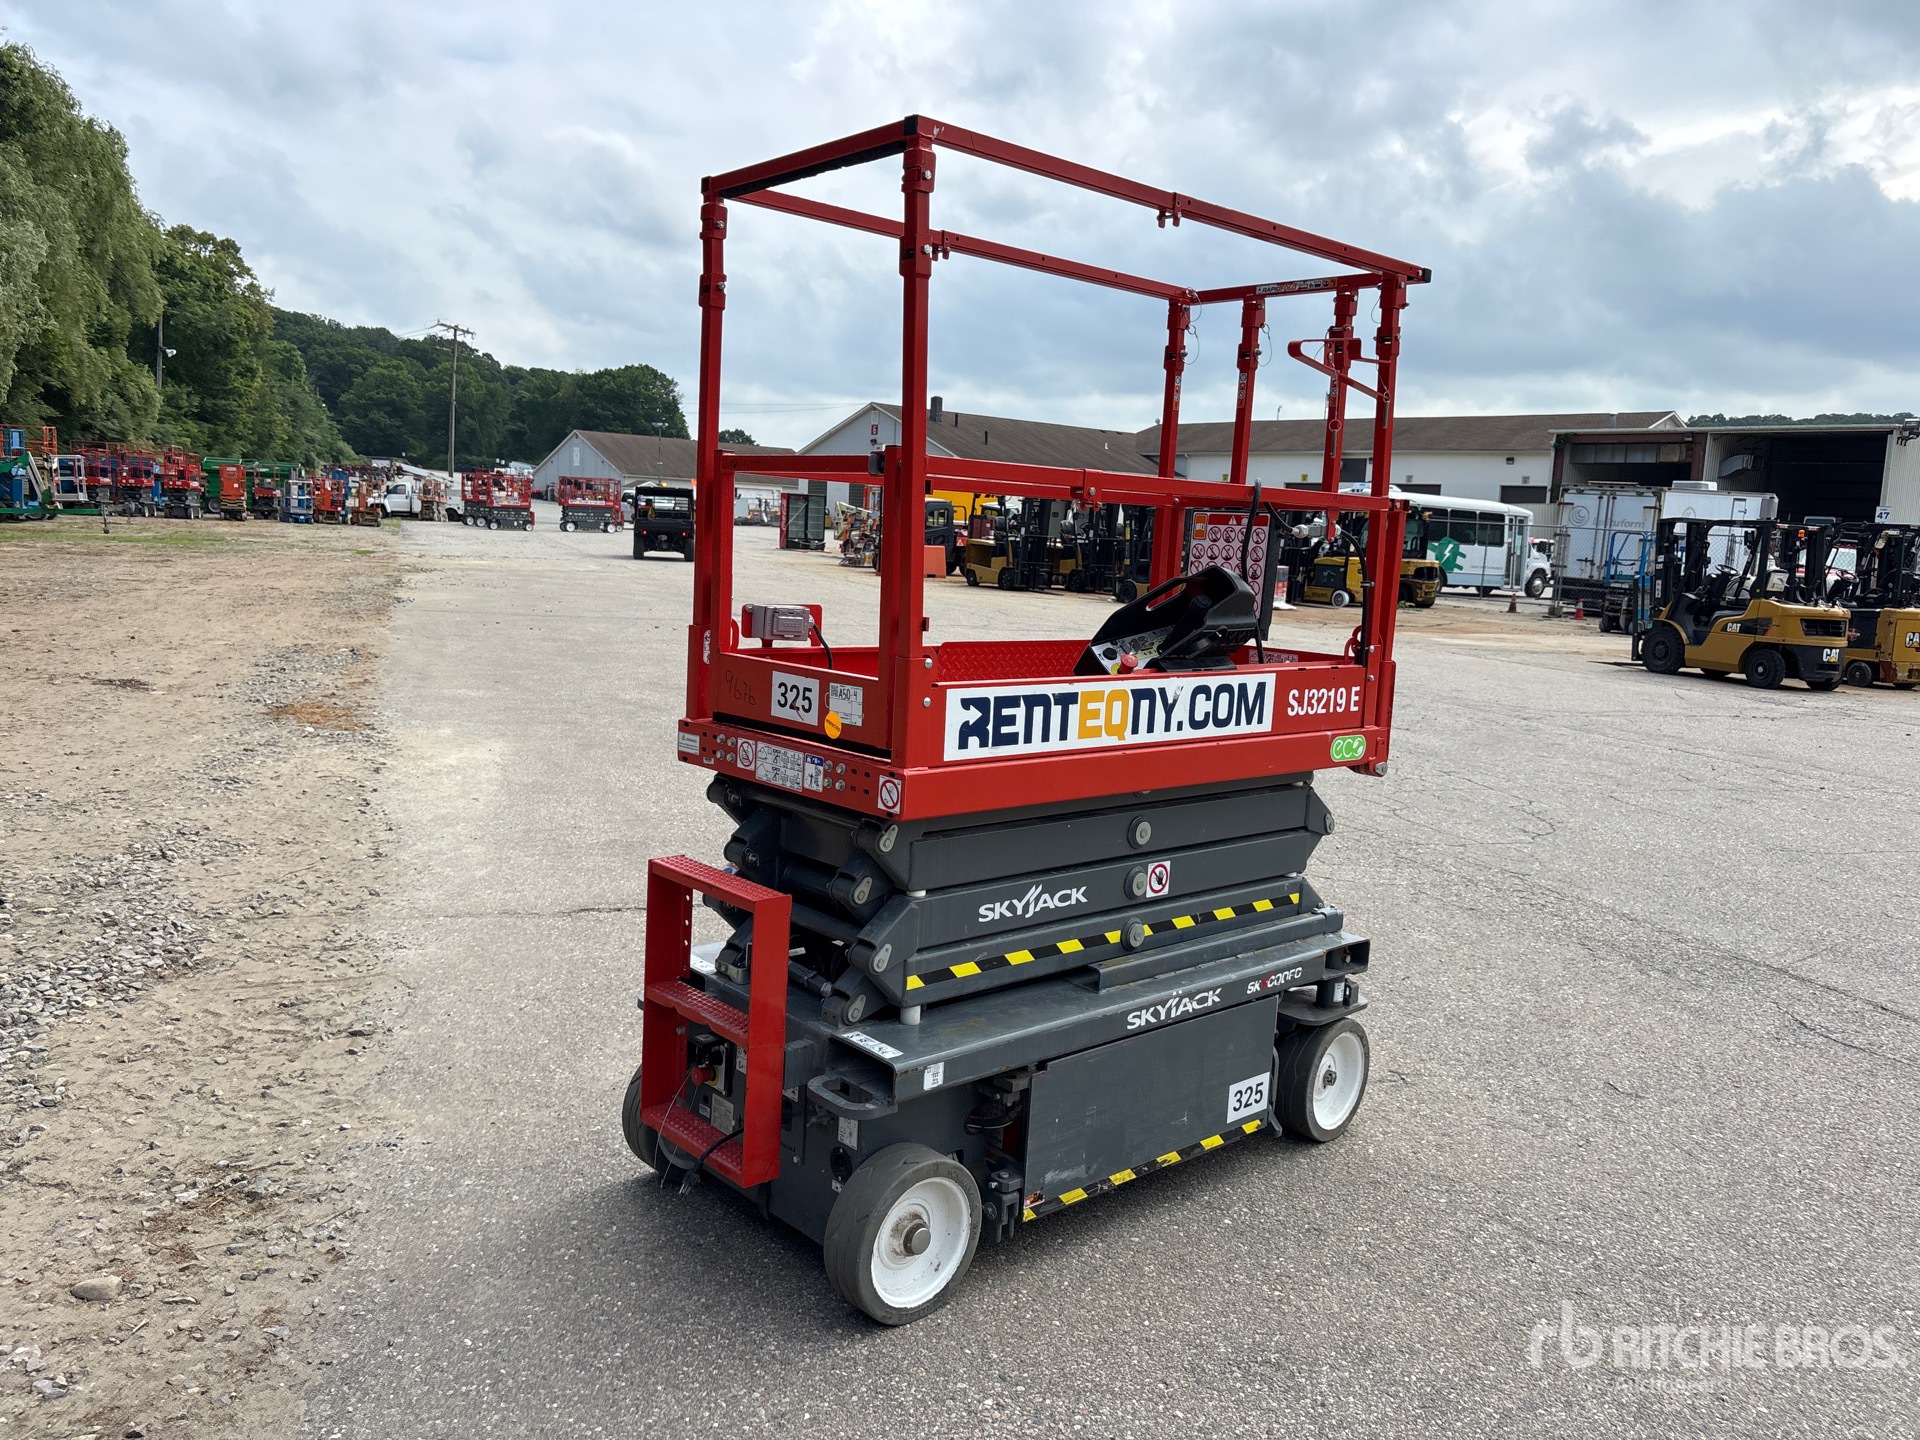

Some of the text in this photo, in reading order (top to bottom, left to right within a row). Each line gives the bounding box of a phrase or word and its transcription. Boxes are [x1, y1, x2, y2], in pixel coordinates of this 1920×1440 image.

[1877, 511, 1890, 520] 47
[1726, 622, 1741, 632] CAT
[1906, 632, 1920, 647] CA
[1822, 648, 1840, 662] CAT
[777, 682, 813, 713] 325
[1287, 686, 1361, 716] SJ3219 E
[957, 681, 1266, 750] RENTEQNY.COM
[1332, 737, 1364, 759] eco
[978, 883, 1088, 923] SKYJACK
[1126, 987, 1222, 1030] SKYJACK
[1232, 1081, 1265, 1114] 325
